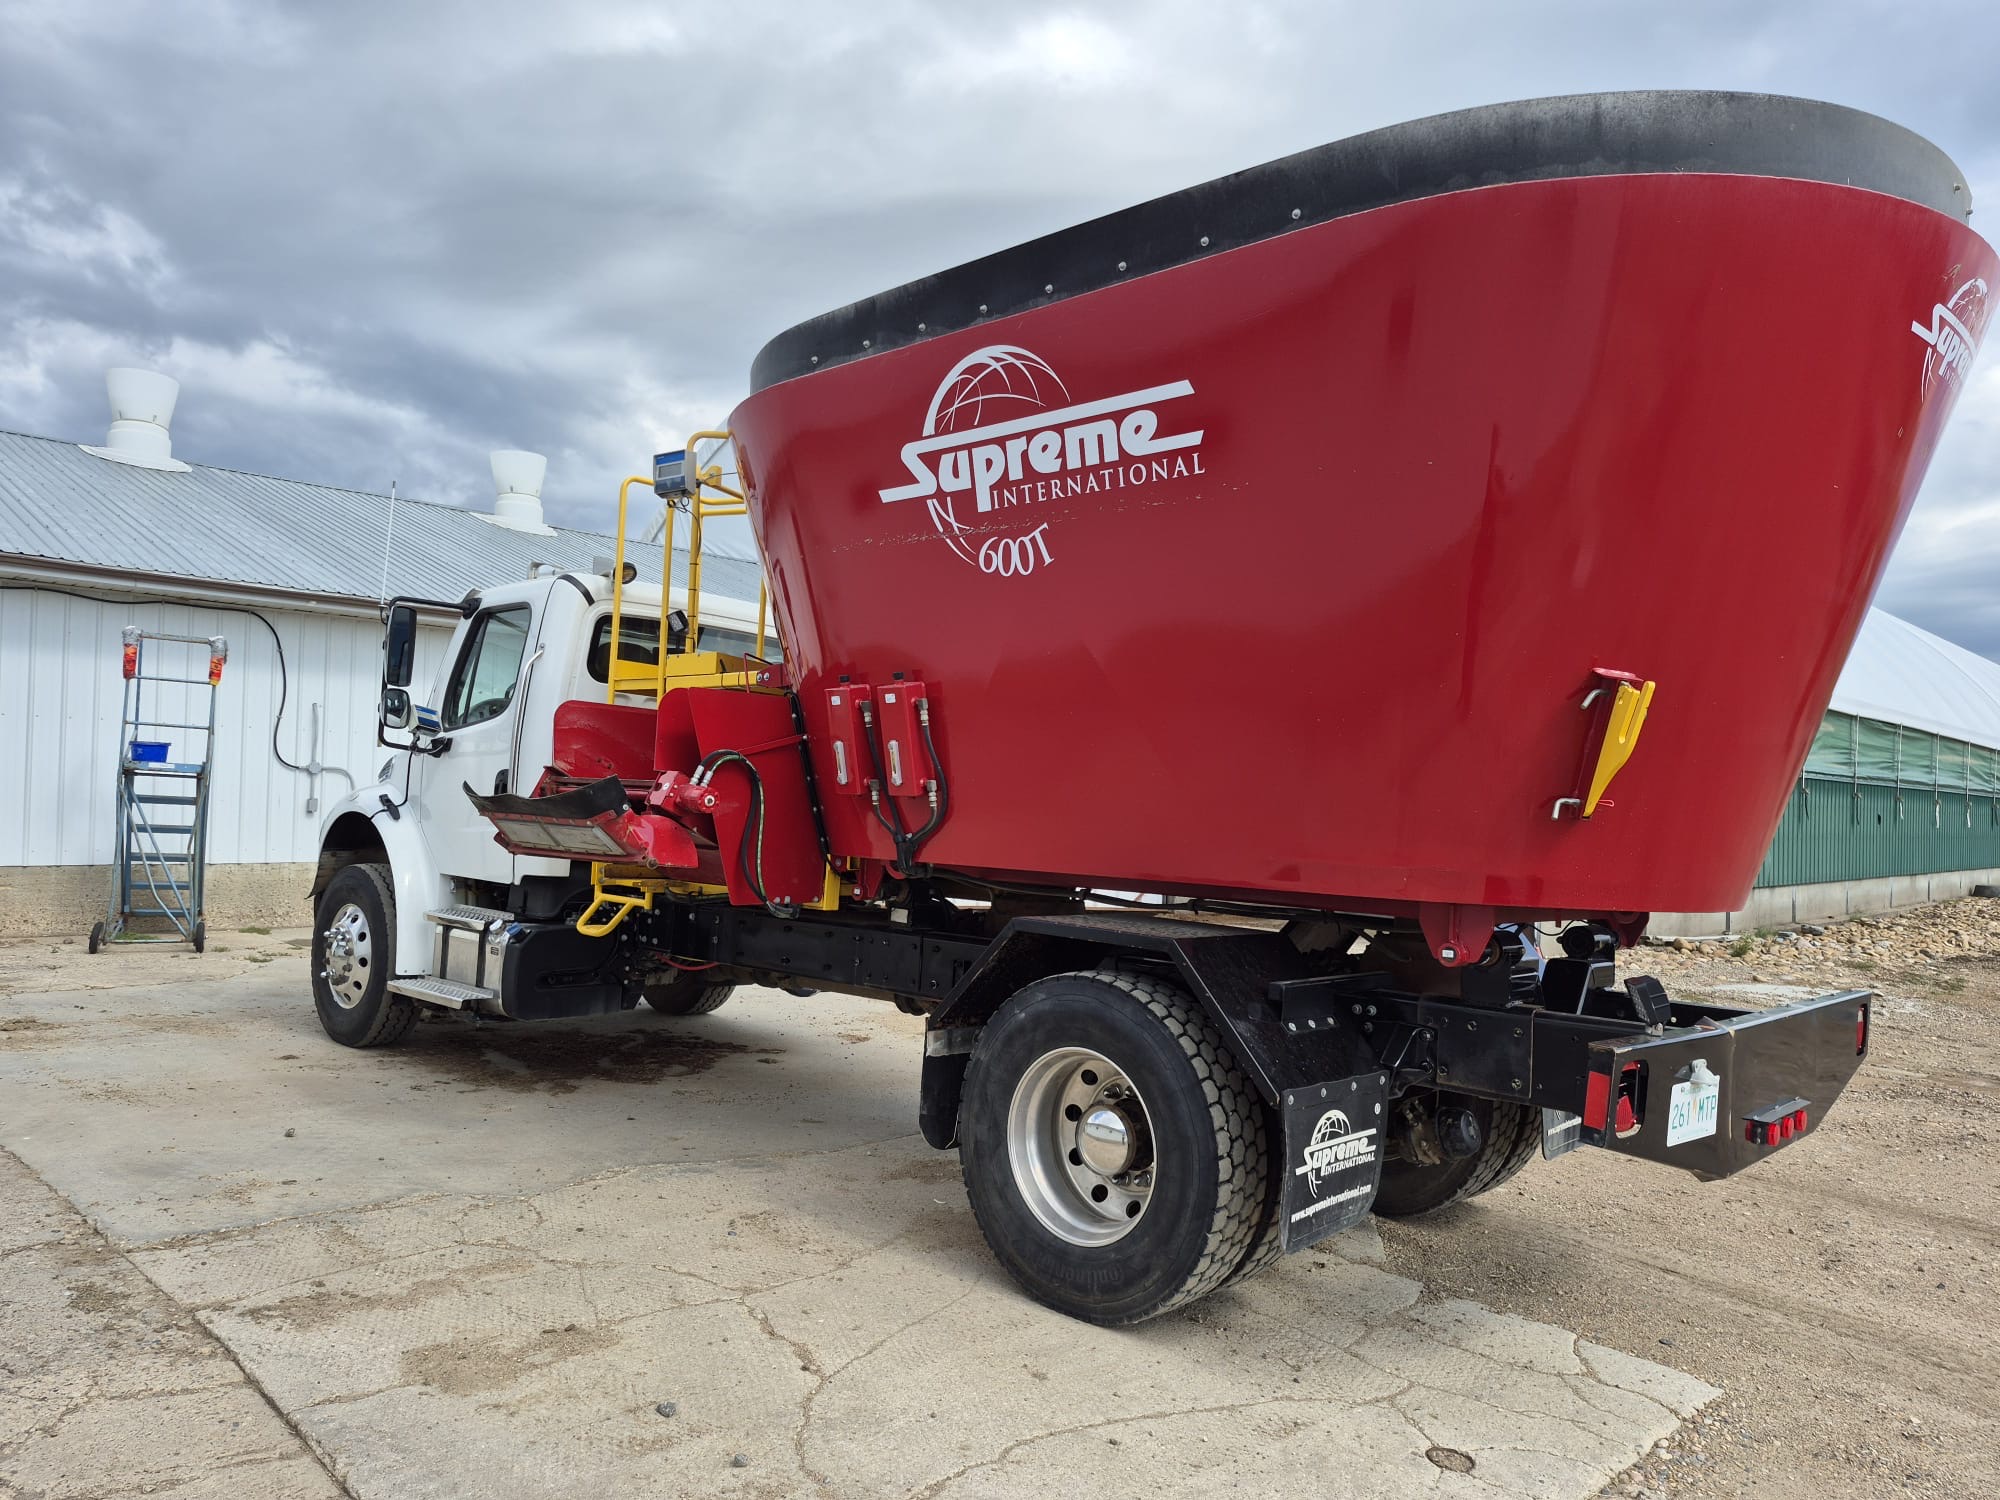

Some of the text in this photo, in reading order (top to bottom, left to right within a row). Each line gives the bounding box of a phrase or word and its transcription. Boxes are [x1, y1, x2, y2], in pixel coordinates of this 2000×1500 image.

[878, 379, 1204, 513] Supreme
[992, 452, 1206, 510] INTERNATIONAL
[978, 522, 1055, 577] 600T
[1671, 1094, 1717, 1130] 261 MTP
[1296, 1129, 1376, 1176] Supreme
[1325, 1152, 1375, 1175] INTERNATIONAL
